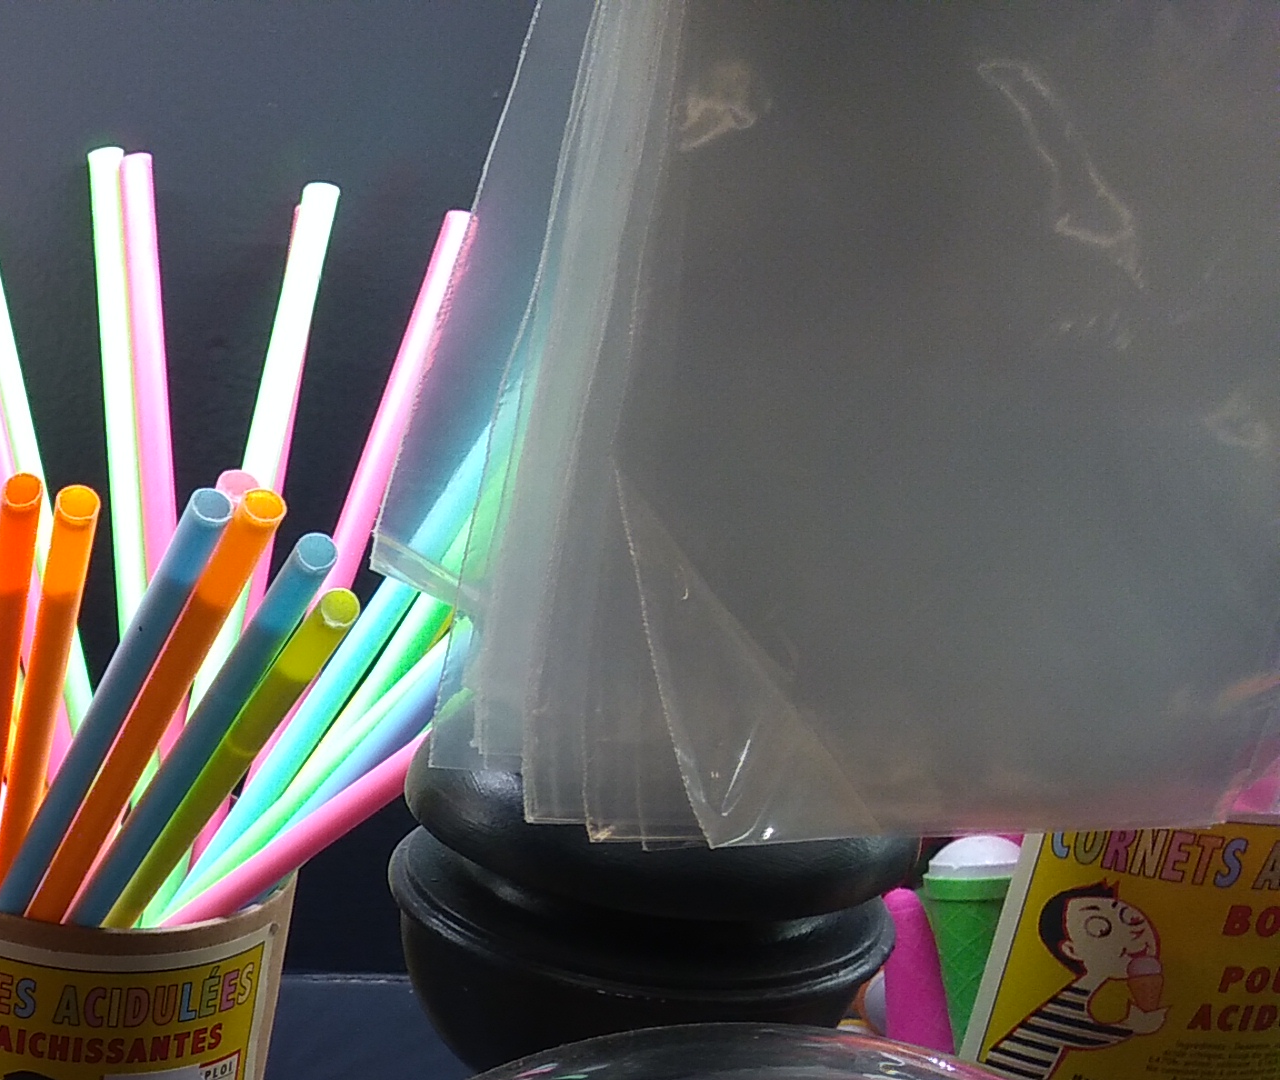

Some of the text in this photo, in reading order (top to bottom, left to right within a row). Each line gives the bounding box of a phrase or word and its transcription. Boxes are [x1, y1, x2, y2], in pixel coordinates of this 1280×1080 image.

[53, 961, 255, 1028] ACIDULÉES
[1187, 1003, 1280, 1032] ACID
[200, 1061, 233, 1080] PLOI
